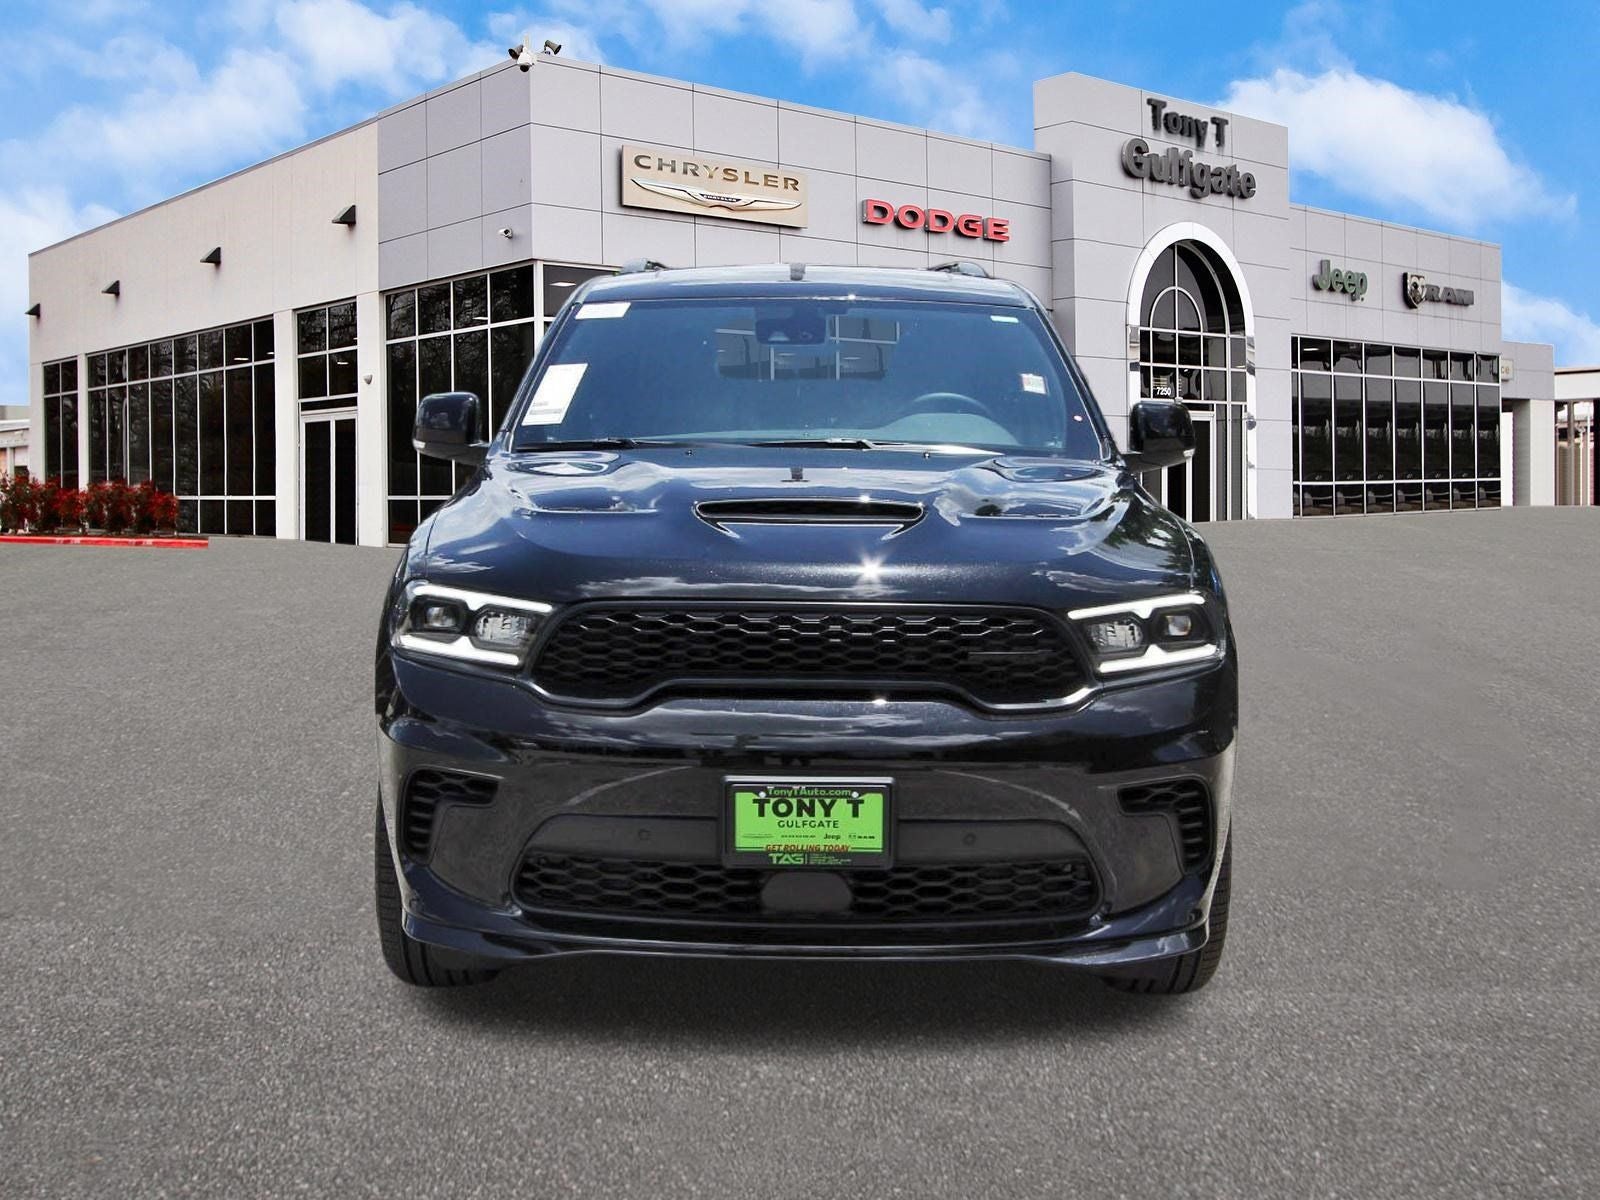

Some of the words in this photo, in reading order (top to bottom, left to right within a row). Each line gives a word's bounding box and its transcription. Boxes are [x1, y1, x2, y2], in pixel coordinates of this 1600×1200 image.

[1147, 98, 1208, 147] Tony
[1210, 117, 1229, 148] T
[634, 154, 800, 192] CHRYSLER
[1121, 138, 1257, 199] Gulfgate
[862, 199, 1011, 242] DODGE
[1313, 259, 1368, 301] Jeep
[1425, 284, 1475, 306] RAM
[1156, 387, 1172, 396] 7250
[767, 786, 851, 797] TonyTAuto.com
[752, 798, 839, 818] TONY
[847, 799, 865, 818] T
[777, 820, 840, 829] GULFGATE
[768, 853, 805, 865] TAG
